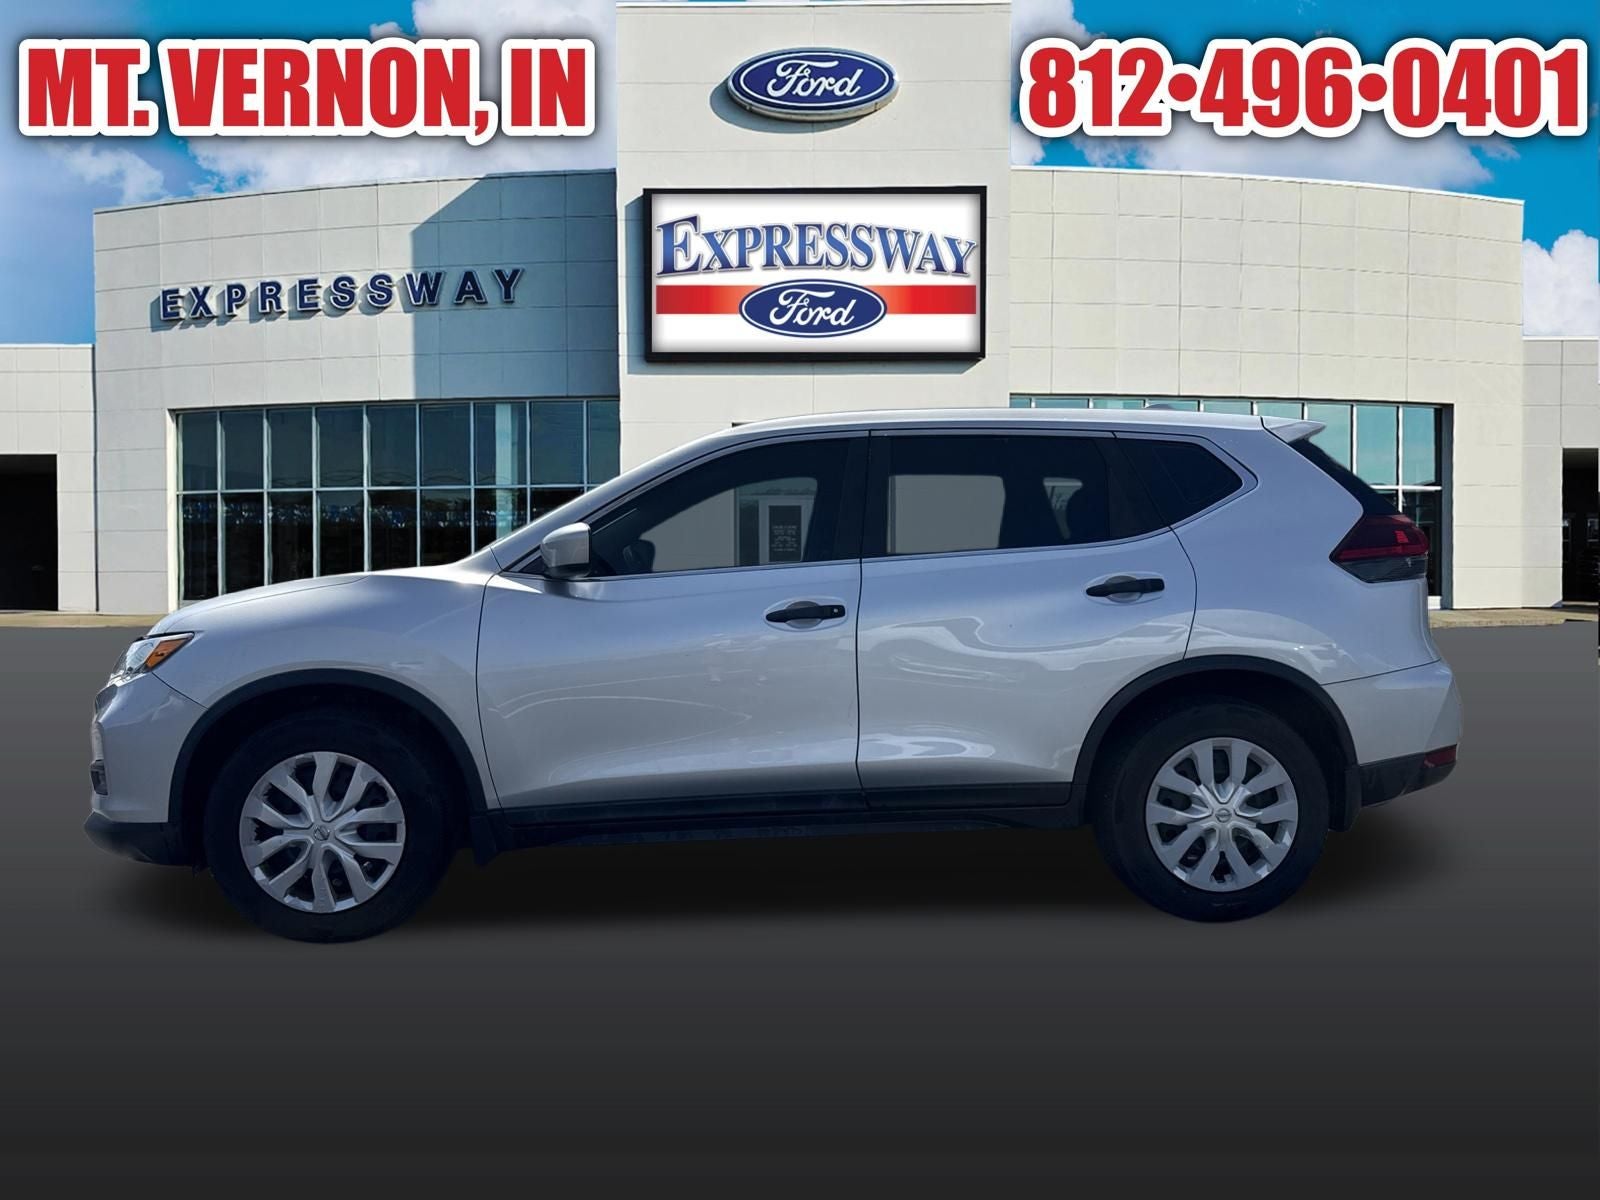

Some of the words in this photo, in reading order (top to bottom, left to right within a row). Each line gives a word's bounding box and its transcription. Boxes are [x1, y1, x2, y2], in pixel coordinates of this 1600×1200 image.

[766, 59, 865, 98] Ford
[656, 214, 978, 277] EXPRESSWAY
[160, 267, 526, 322] EXPRESSWAY
[768, 288, 857, 327] Ford
